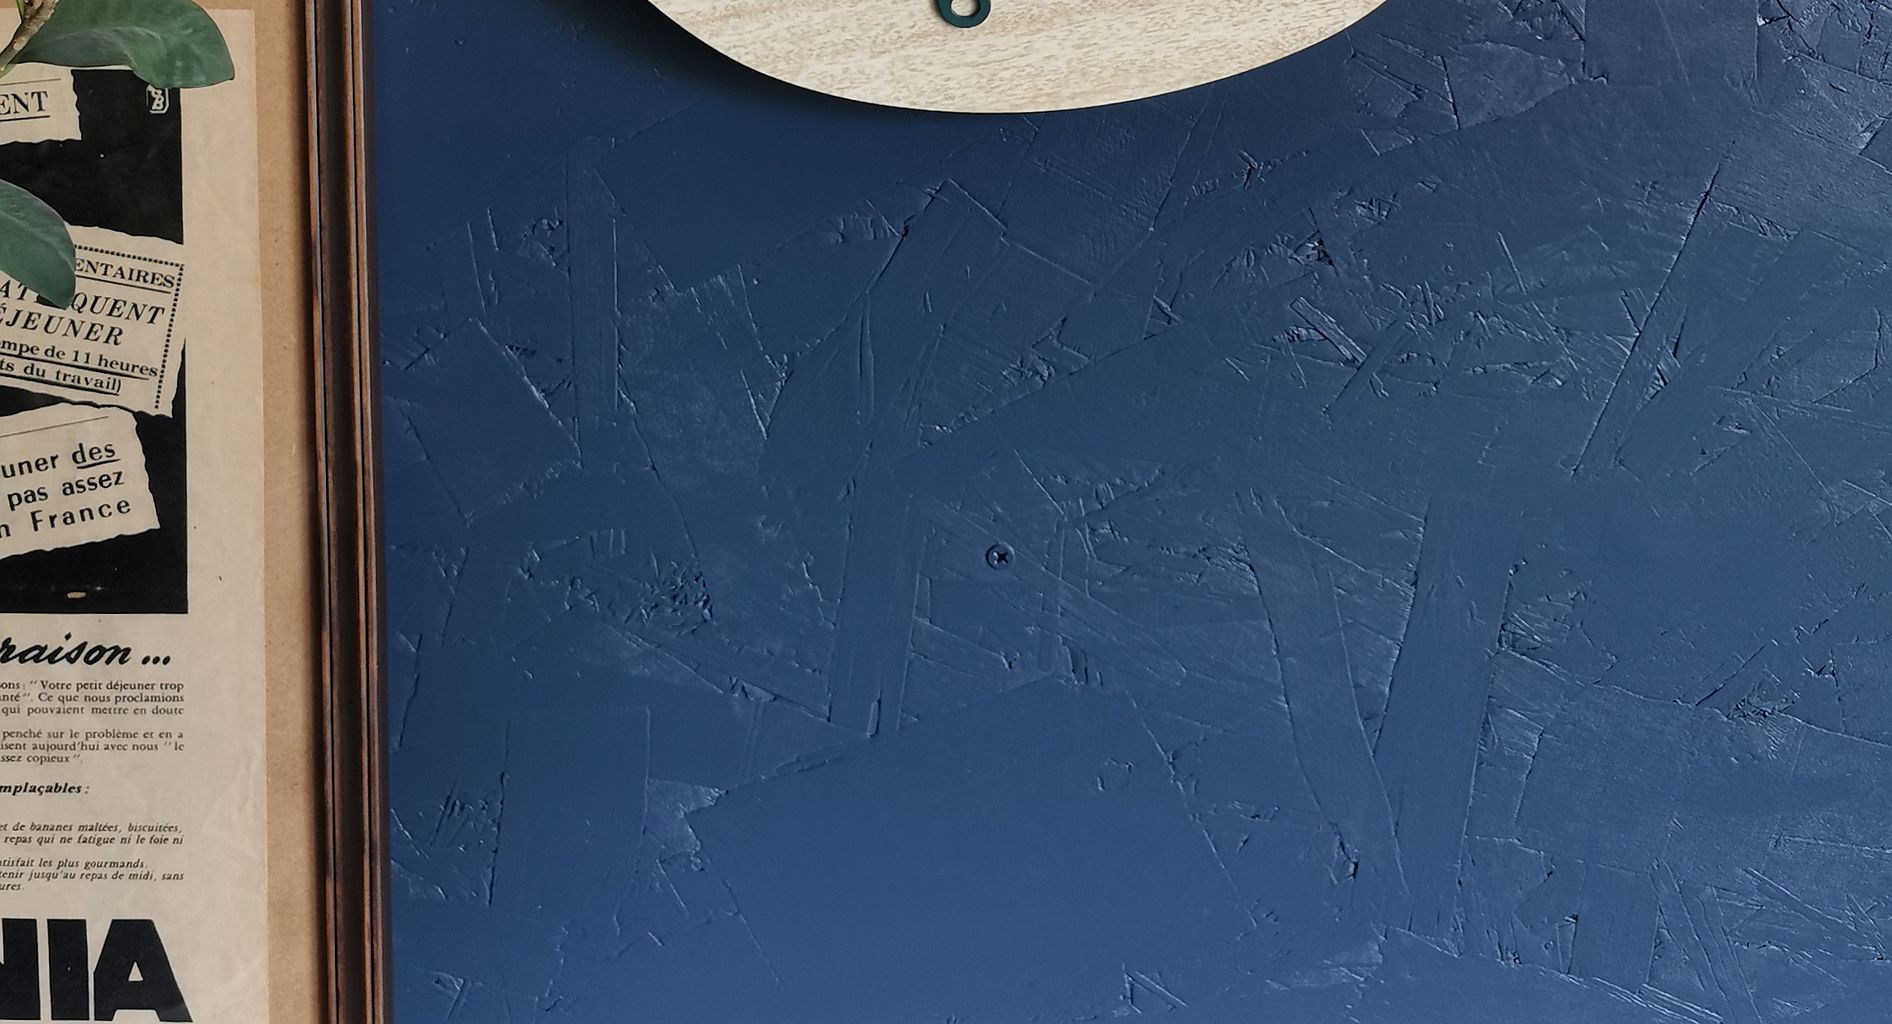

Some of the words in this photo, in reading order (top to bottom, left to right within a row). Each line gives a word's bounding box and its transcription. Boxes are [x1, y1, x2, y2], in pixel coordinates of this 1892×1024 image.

[0, 90, 48, 115] ENT
[0, 340, 40, 356] mpe
[44, 344, 66, 360] de
[72, 349, 91, 365] 11
[98, 354, 159, 377] heures
[23, 362, 46, 378] du
[56, 368, 122, 393] travail)
[1, 454, 59, 479] uner
[71, 442, 117, 466] des
[7, 485, 49, 512] pas
[62, 470, 125, 497] assez
[30, 498, 131, 532] France
[76, 680, 102, 692] petit
[105, 679, 156, 693] déjeuner
[160, 682, 185, 693] trop
[38, 691, 54, 702] Ce
[57, 694, 79, 705] que
[83, 694, 111, 703] nous
[114, 692, 185, 705] proclamions
[1, 704, 21, 716] qui
[27, 704, 85, 717] pouvaient
[91, 706, 129, 715] mettre
[133, 707, 147, 715] en
[151, 705, 185, 715] doute
[2, 728, 43, 741] penché
[47, 730, 65, 739] sur
[69, 728, 80, 739] le
[85, 728, 139, 741] problème
[142, 730, 155, 739] et
[158, 730, 173, 739] en
[32, 740, 100, 752] aujourd'hui
[103, 742, 128, 751] avec
[132, 742, 159, 751] nous
[12, 821, 26, 831] de
[29, 821, 73, 832] bananes
[78, 822, 122, 833] maltées,
[127, 822, 183, 834] biscuitées,
[4, 836, 32, 846] repas
[36, 834, 55, 846] qui
[59, 836, 73, 844] ne
[77, 834, 116, 847] fatigue
[120, 834, 132, 845] ni
[135, 834, 146, 844] le
[149, 834, 169, 845] foie
[172, 834, 184, 845] ni
[38, 857, 53, 868] les
[56, 858, 80, 870] plus
[83, 858, 148, 871] gourmands.
[27, 868, 76, 882] jusqu'au
[79, 871, 108, 882] repas
[111, 871, 124, 880] de
[128, 870, 157, 882] midi,
[161, 872, 185, 881] sans
